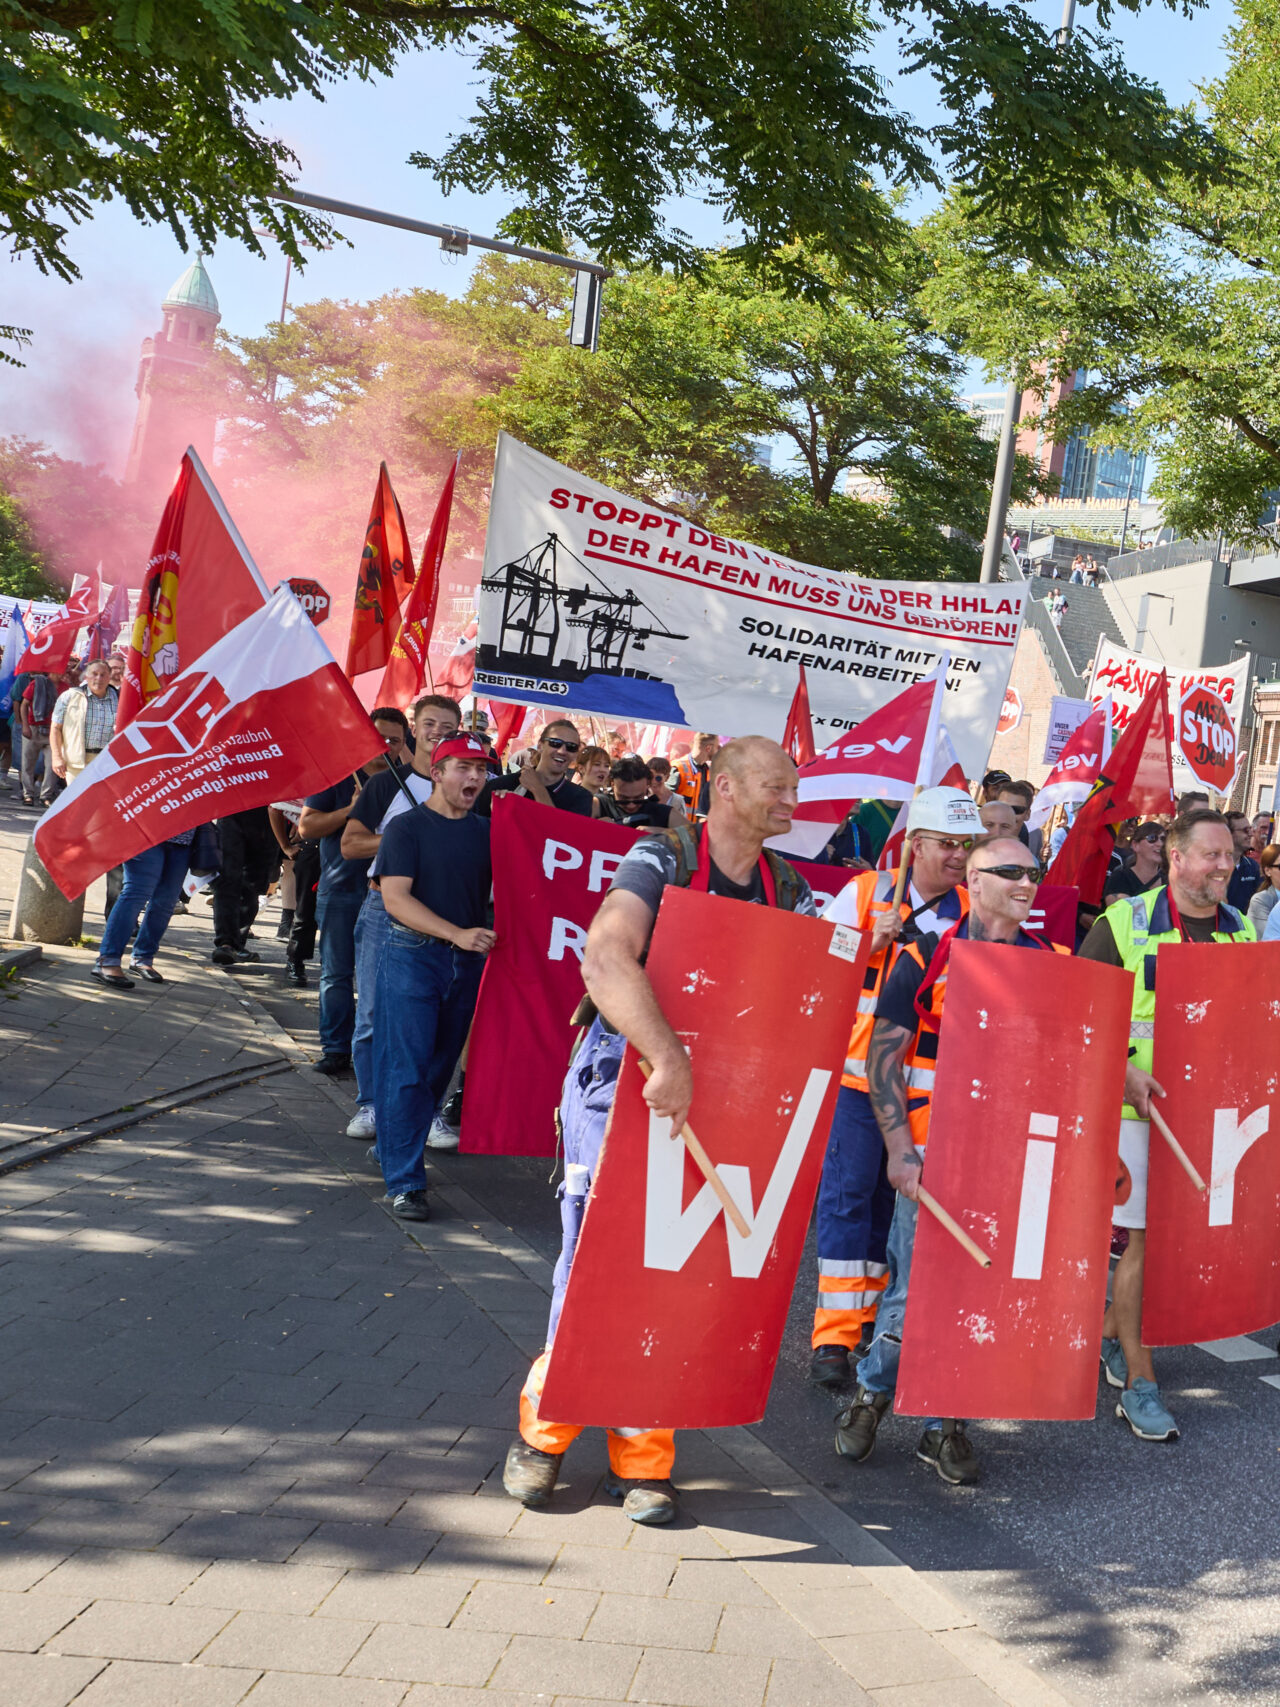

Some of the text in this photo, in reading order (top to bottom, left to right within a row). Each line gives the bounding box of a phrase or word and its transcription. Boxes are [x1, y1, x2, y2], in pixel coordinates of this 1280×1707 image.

[1048, 496, 1082, 510] HAFEN
[549, 488, 681, 538] STOPPT
[688, 527, 748, 559] DEN
[880, 589, 932, 609] DER
[942, 595, 1021, 615] HHLA!
[587, 528, 1018, 638] DER HAFEN MUSS UNS GEHÖREN!
[739, 617, 892, 659] SOLIDARITÄT
[895, 649, 936, 666] MIT
[1183, 709, 1234, 760] STOP
[1194, 701, 1226, 726] MSC
[644, 1069, 832, 1278] W
[1012, 1112, 1058, 1280] i
